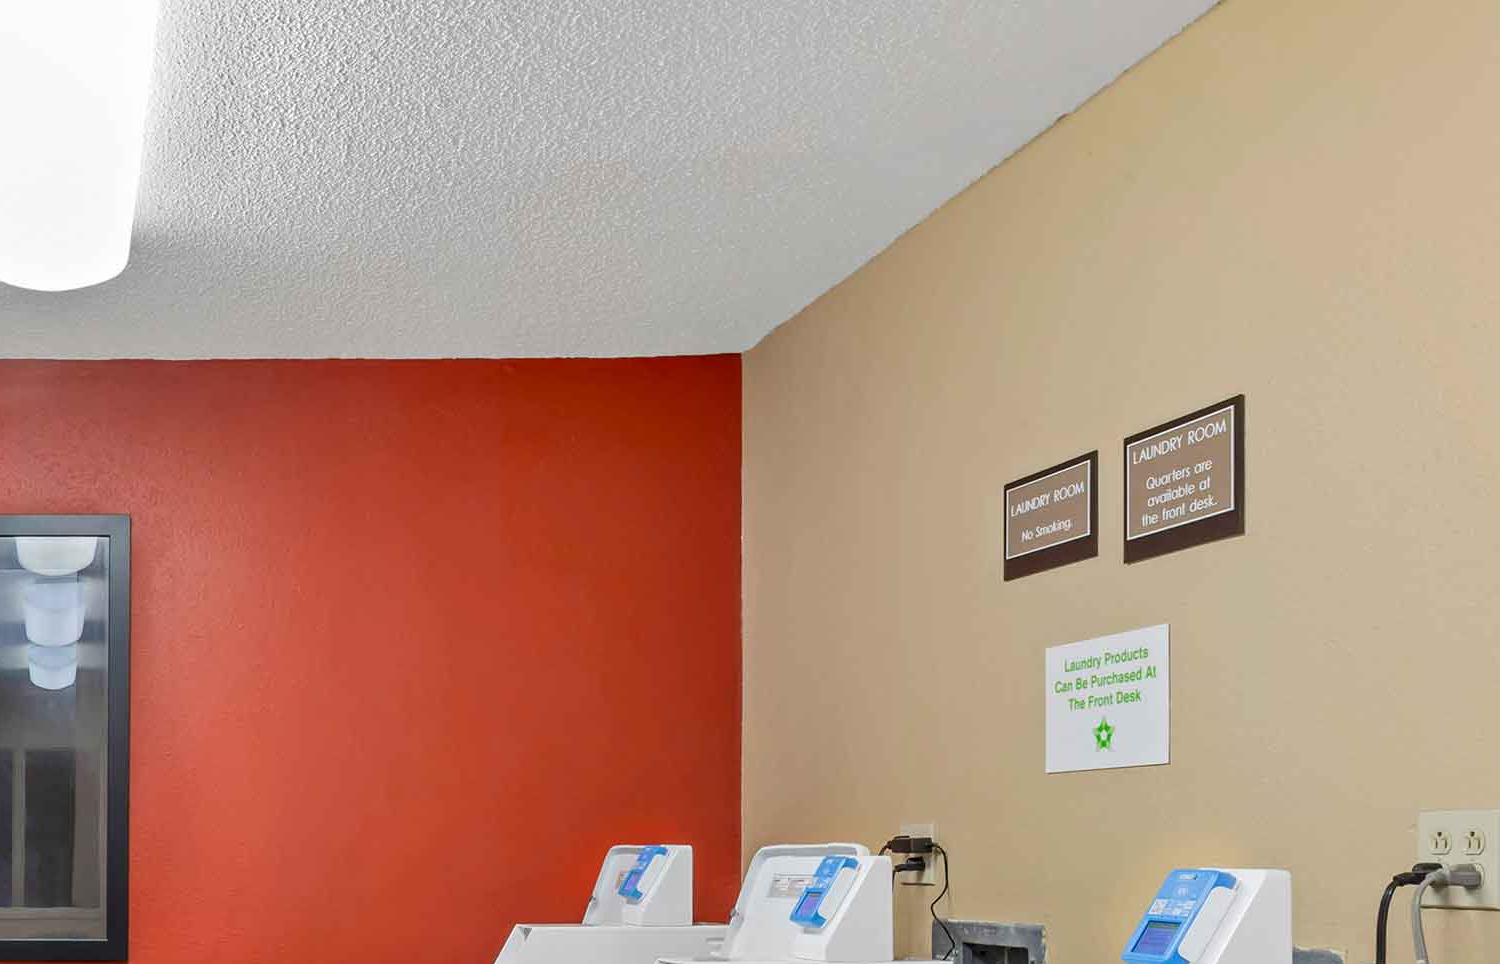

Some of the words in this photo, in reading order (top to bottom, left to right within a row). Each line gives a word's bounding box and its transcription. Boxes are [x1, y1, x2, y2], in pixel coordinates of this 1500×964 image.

[1133, 437, 1183, 465] LAUNDRY
[1187, 419, 1227, 443] ROOM
[1146, 466, 1190, 490] Quarters
[1194, 458, 1213, 473] are
[1011, 491, 1050, 517] LAUNDRY
[1053, 481, 1085, 502] ROOM
[1147, 482, 1195, 507] available
[1198, 476, 1211, 492] at
[1141, 510, 1158, 528] the
[1162, 503, 1186, 522] front
[1189, 495, 1218, 516] desk.
[1021, 527, 1034, 543] No
[1064, 655, 1102, 673] Laundry
[1104, 646, 1149, 665] Products
[1055, 679, 1074, 694] Can
[1075, 677, 1088, 691] Be
[1090, 669, 1143, 689] Purchased
[1145, 666, 1157, 680] At
[1068, 697, 1085, 711] The
[1088, 693, 1113, 709] Front
[1116, 689, 1141, 704] Desk
